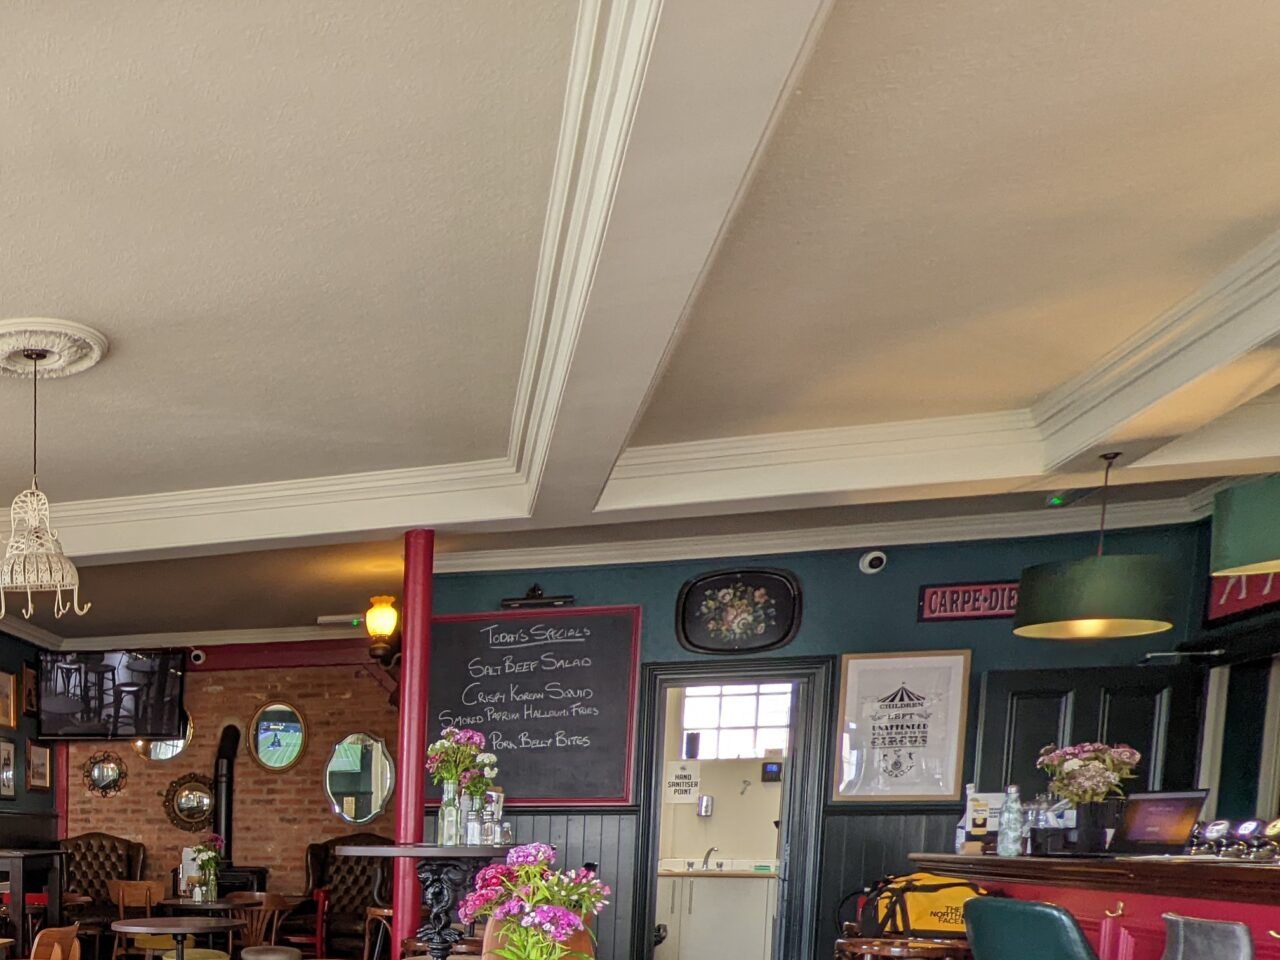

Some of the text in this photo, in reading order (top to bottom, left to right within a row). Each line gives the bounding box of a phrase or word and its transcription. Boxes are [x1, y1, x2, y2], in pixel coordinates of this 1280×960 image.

[928, 586, 1019, 614] CARPE DIE
[468, 652, 592, 678] SALT BEEF SALAD
[880, 701, 924, 709] CHILDREN
[887, 712, 915, 720] LEFT
[872, 723, 928, 732] UNATTENDED
[555, 731, 591, 747] BITES
[871, 735, 928, 746] CIRCUS
[938, 917, 960, 925] FACE
